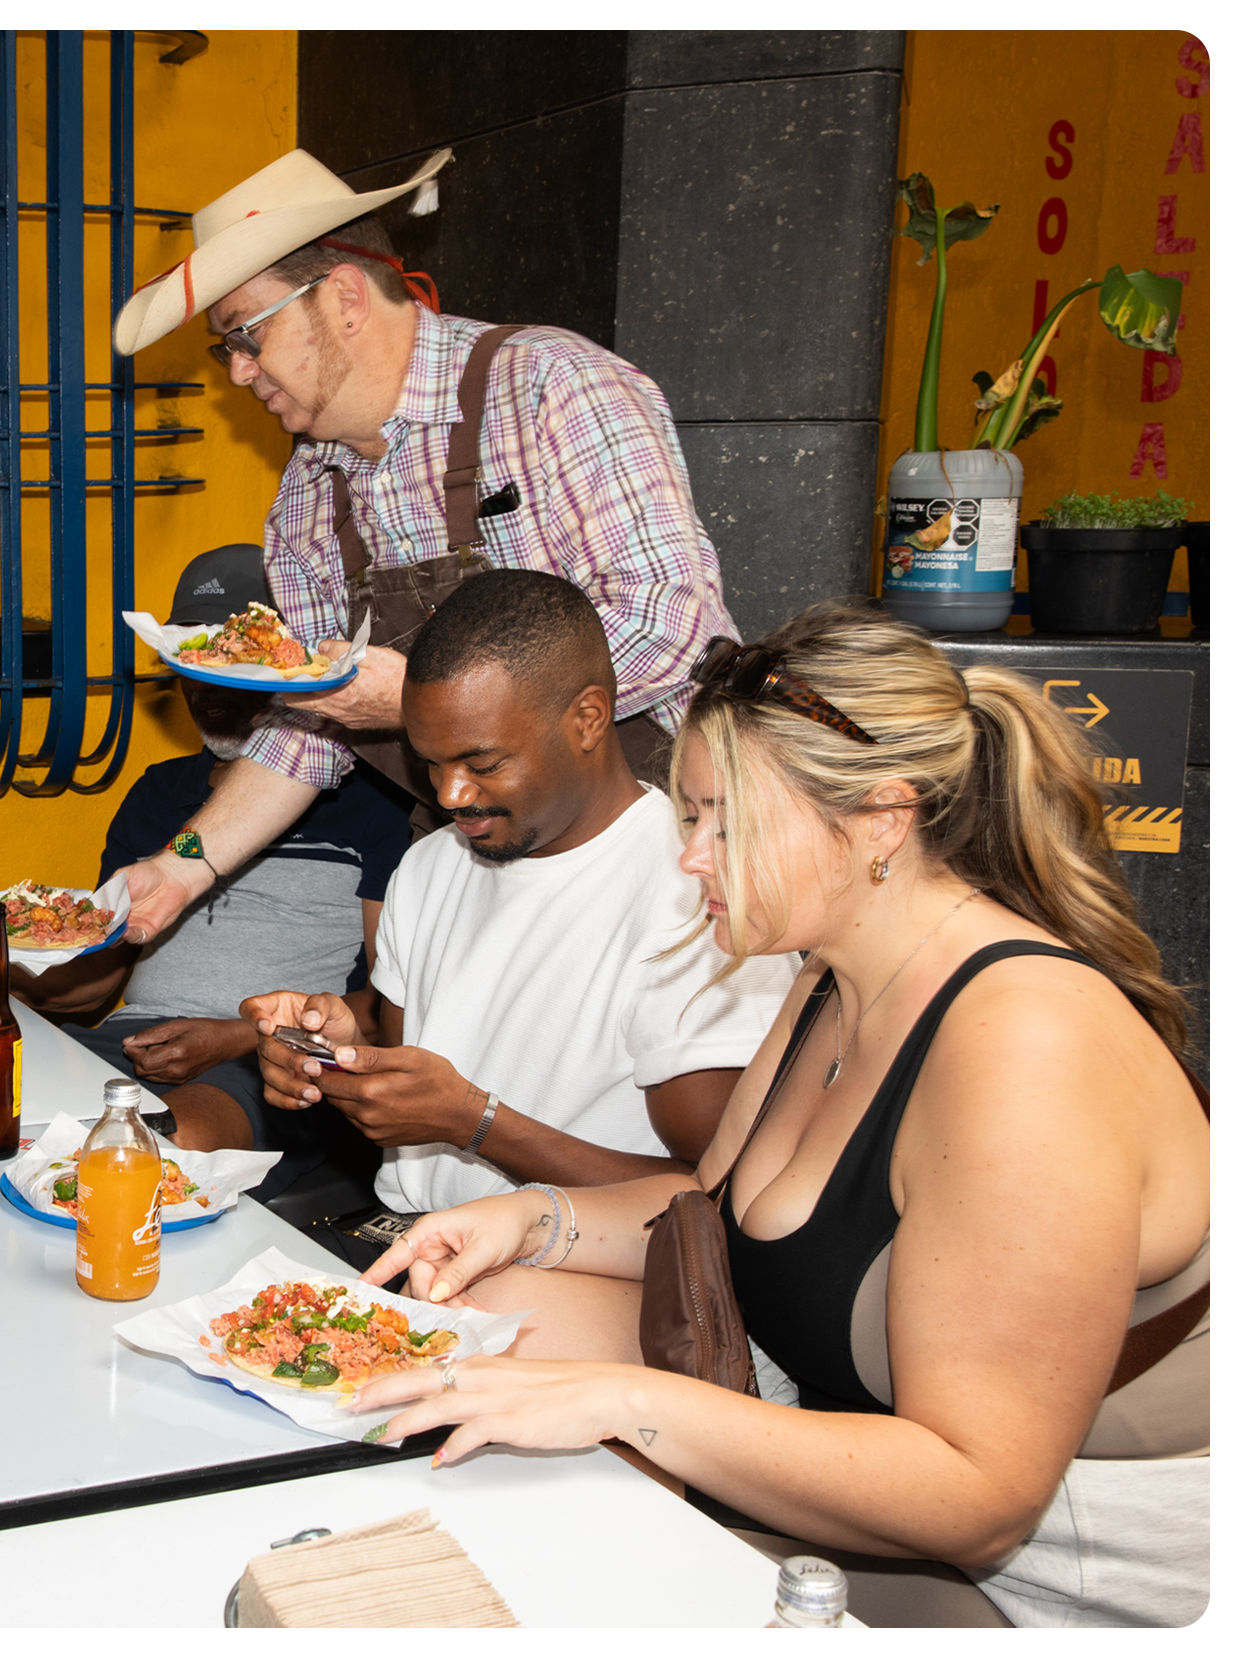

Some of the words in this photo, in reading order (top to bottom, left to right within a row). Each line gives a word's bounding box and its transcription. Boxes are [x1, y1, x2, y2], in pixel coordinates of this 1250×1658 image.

[915, 552, 969, 561] MAYONNAISE
[914, 561, 959, 570] MAYONESA
[193, 587, 225, 595] adidas
